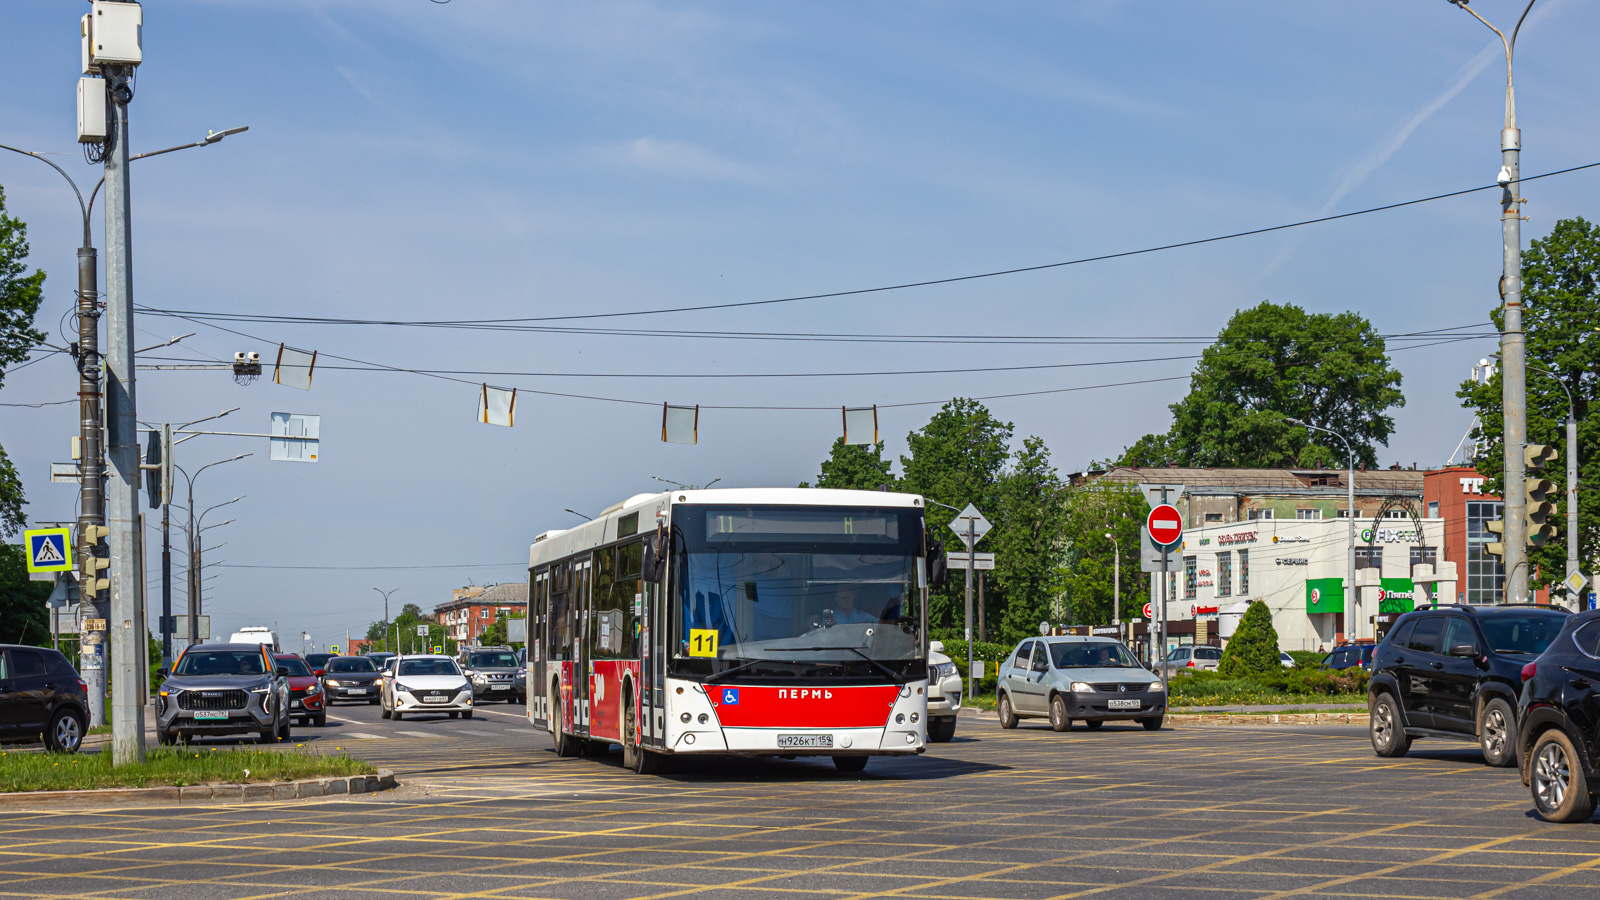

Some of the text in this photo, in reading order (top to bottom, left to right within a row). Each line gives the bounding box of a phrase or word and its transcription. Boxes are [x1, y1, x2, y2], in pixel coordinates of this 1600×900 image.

[720, 515, 734, 533] 11
[1282, 558, 1308, 566] СЕРВИС
[694, 634, 714, 652] 11
[779, 689, 833, 699] ПЕРМЬ
[781, 736, 815, 746] Н926КТ
